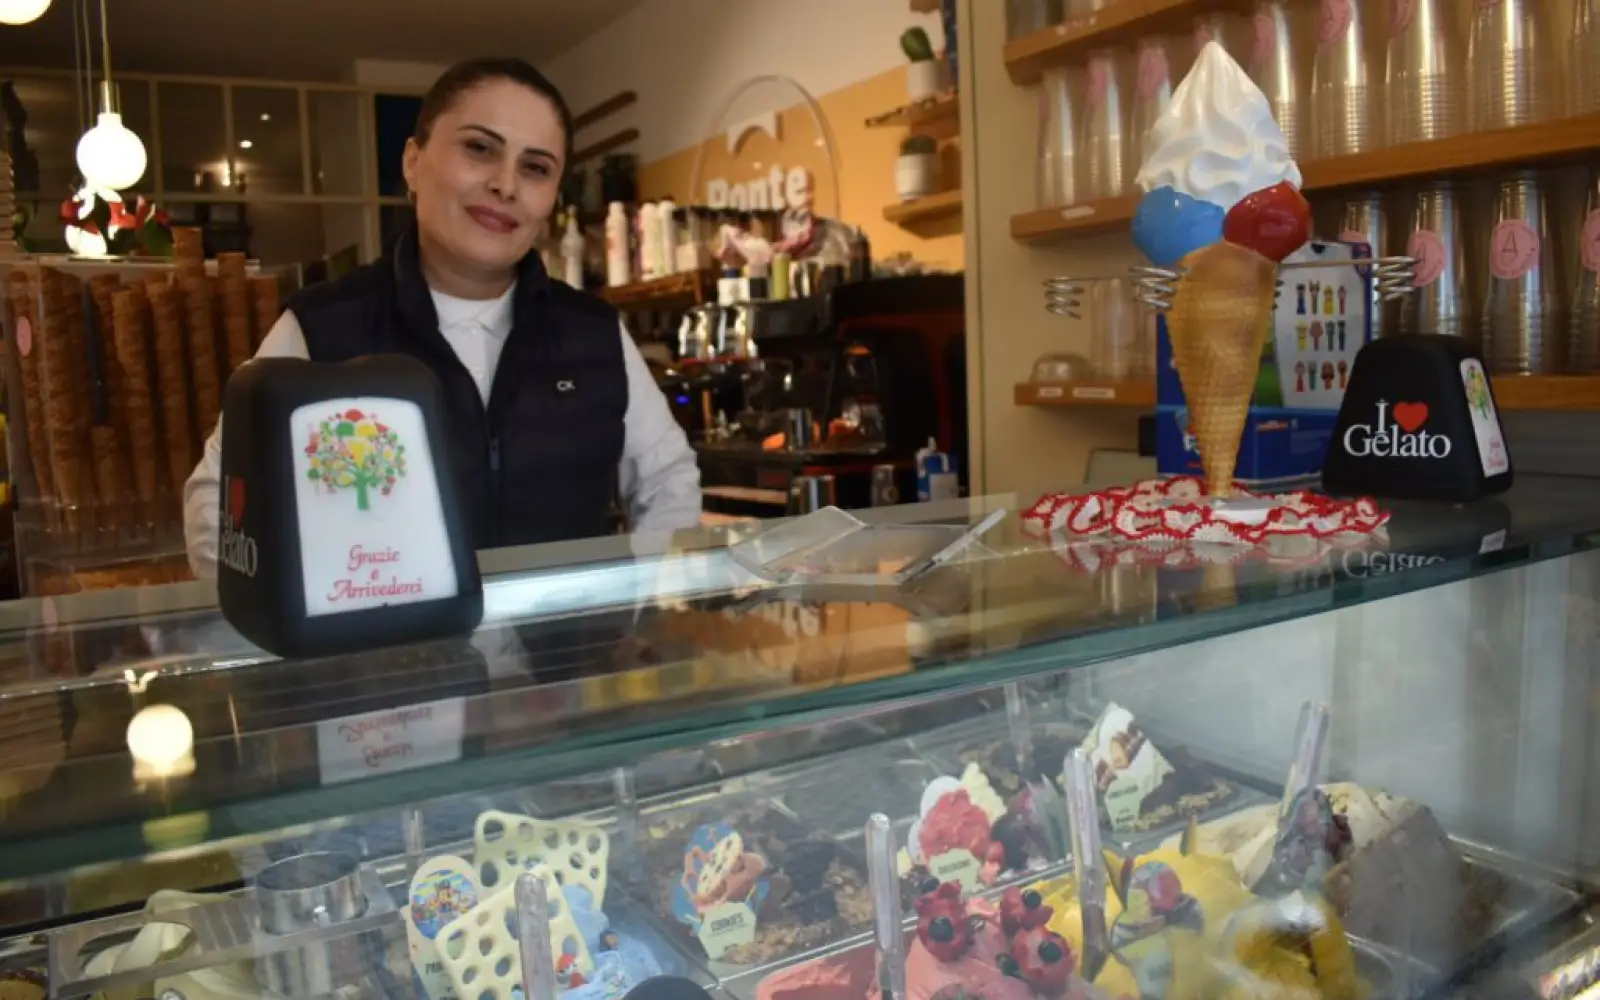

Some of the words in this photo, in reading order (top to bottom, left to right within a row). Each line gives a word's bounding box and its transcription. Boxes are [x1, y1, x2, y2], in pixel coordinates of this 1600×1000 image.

[1375, 399, 1389, 433] I
[1343, 424, 1453, 459] Gelato
[347, 544, 400, 571] Grazie
[370, 568, 380, 581] e
[326, 576, 423, 602] Arrivederci
